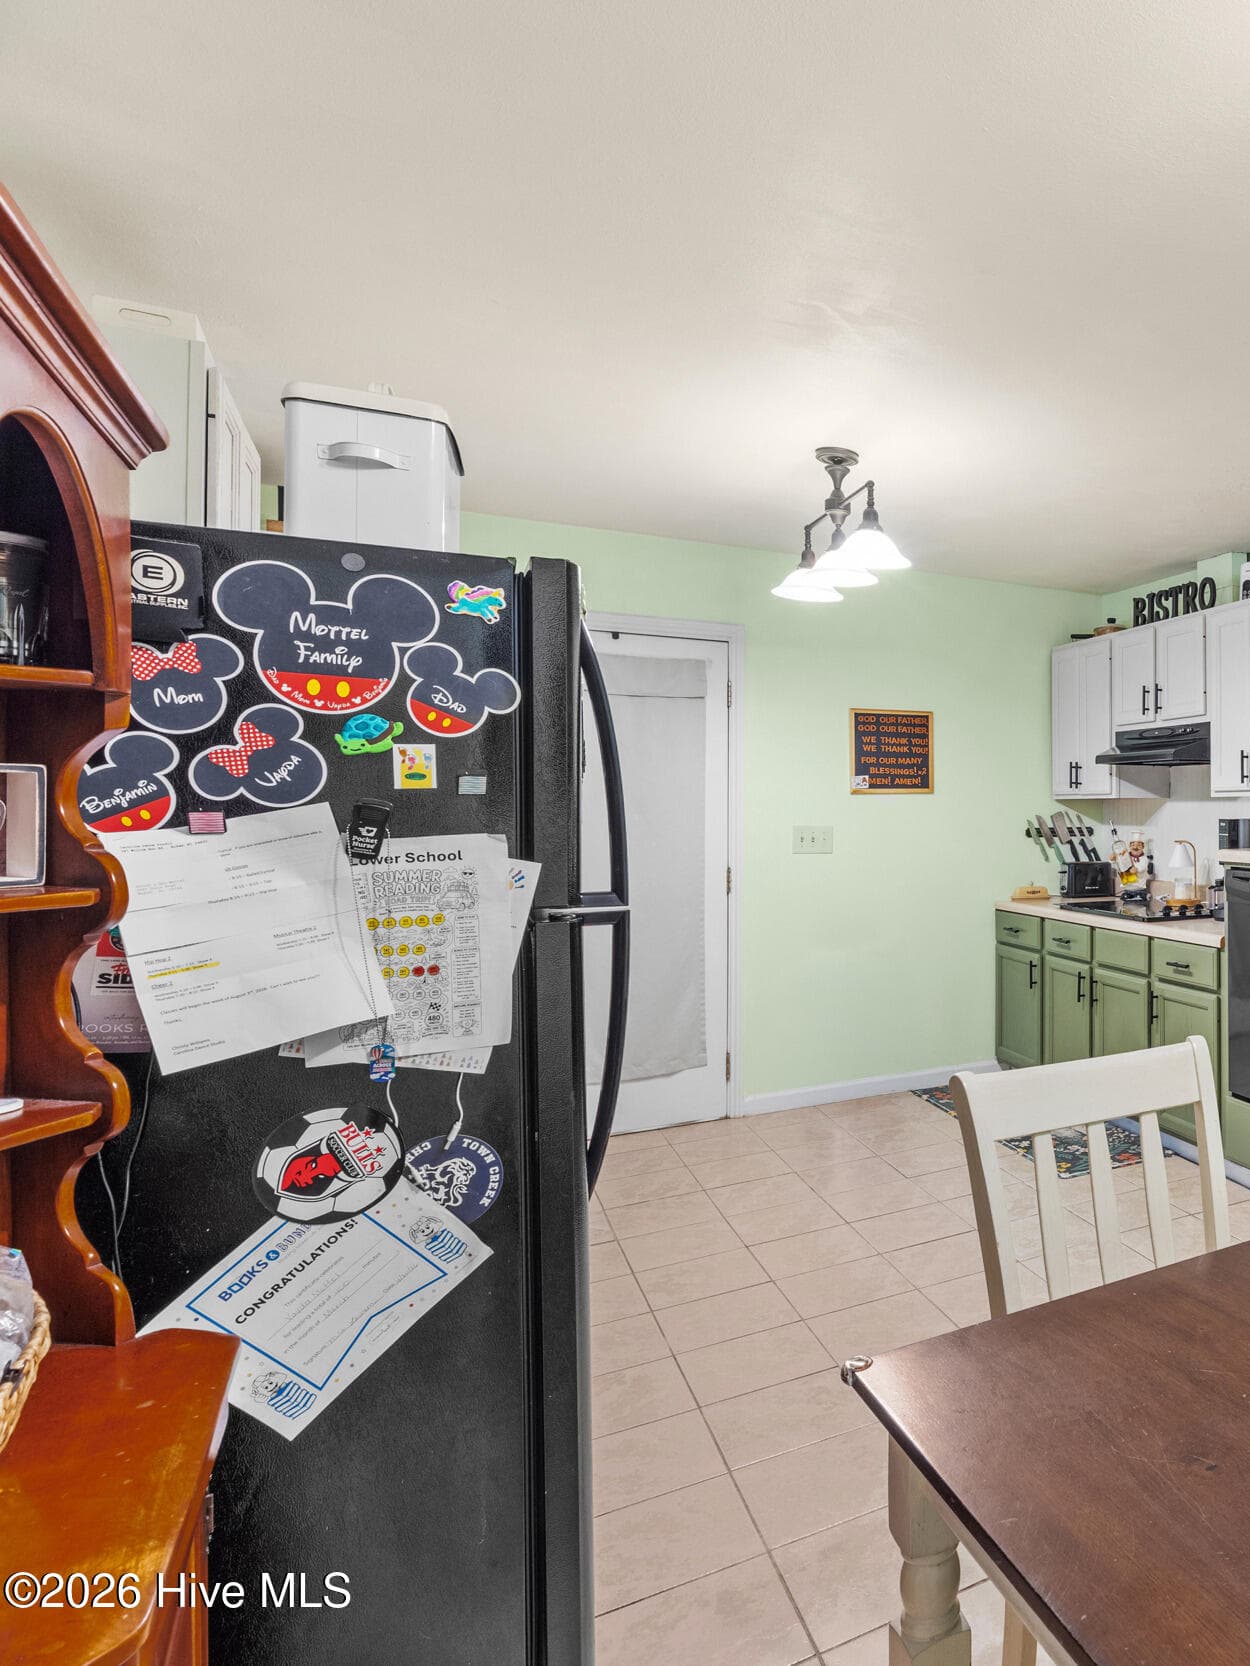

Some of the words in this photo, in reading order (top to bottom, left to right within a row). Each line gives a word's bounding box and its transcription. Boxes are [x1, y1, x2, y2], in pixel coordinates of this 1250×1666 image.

[1132, 577, 1217, 628] BISTRO
[289, 611, 369, 641] Mottel
[294, 640, 363, 674] Family
[153, 686, 204, 708] Mom
[431, 685, 467, 714] Dad
[912, 746, 928, 754] YOU!
[868, 777, 891, 785] MEN!
[894, 777, 921, 785] AMEN!
[870, 767, 917, 775] BLESSINGS!
[80, 779, 158, 814] Benjamin
[352, 835, 378, 844] Pocket
[351, 852, 400, 866] Lower
[405, 851, 462, 863] School
[372, 869, 442, 886] SUMMER
[374, 882, 441, 899] READING
[98, 973, 133, 984] SID
[81, 1024, 133, 1033] OOKS
[328, 1137, 347, 1163] SOCCER
[343, 1161, 361, 1178] CLUB
[338, 1123, 381, 1175] BULLS
[462, 1138, 496, 1164] TOWN
[479, 1166, 500, 1207] CREEK
[218, 1259, 268, 1301] BOOKS
[235, 1218, 358, 1324] CONGRATULATIONS!
